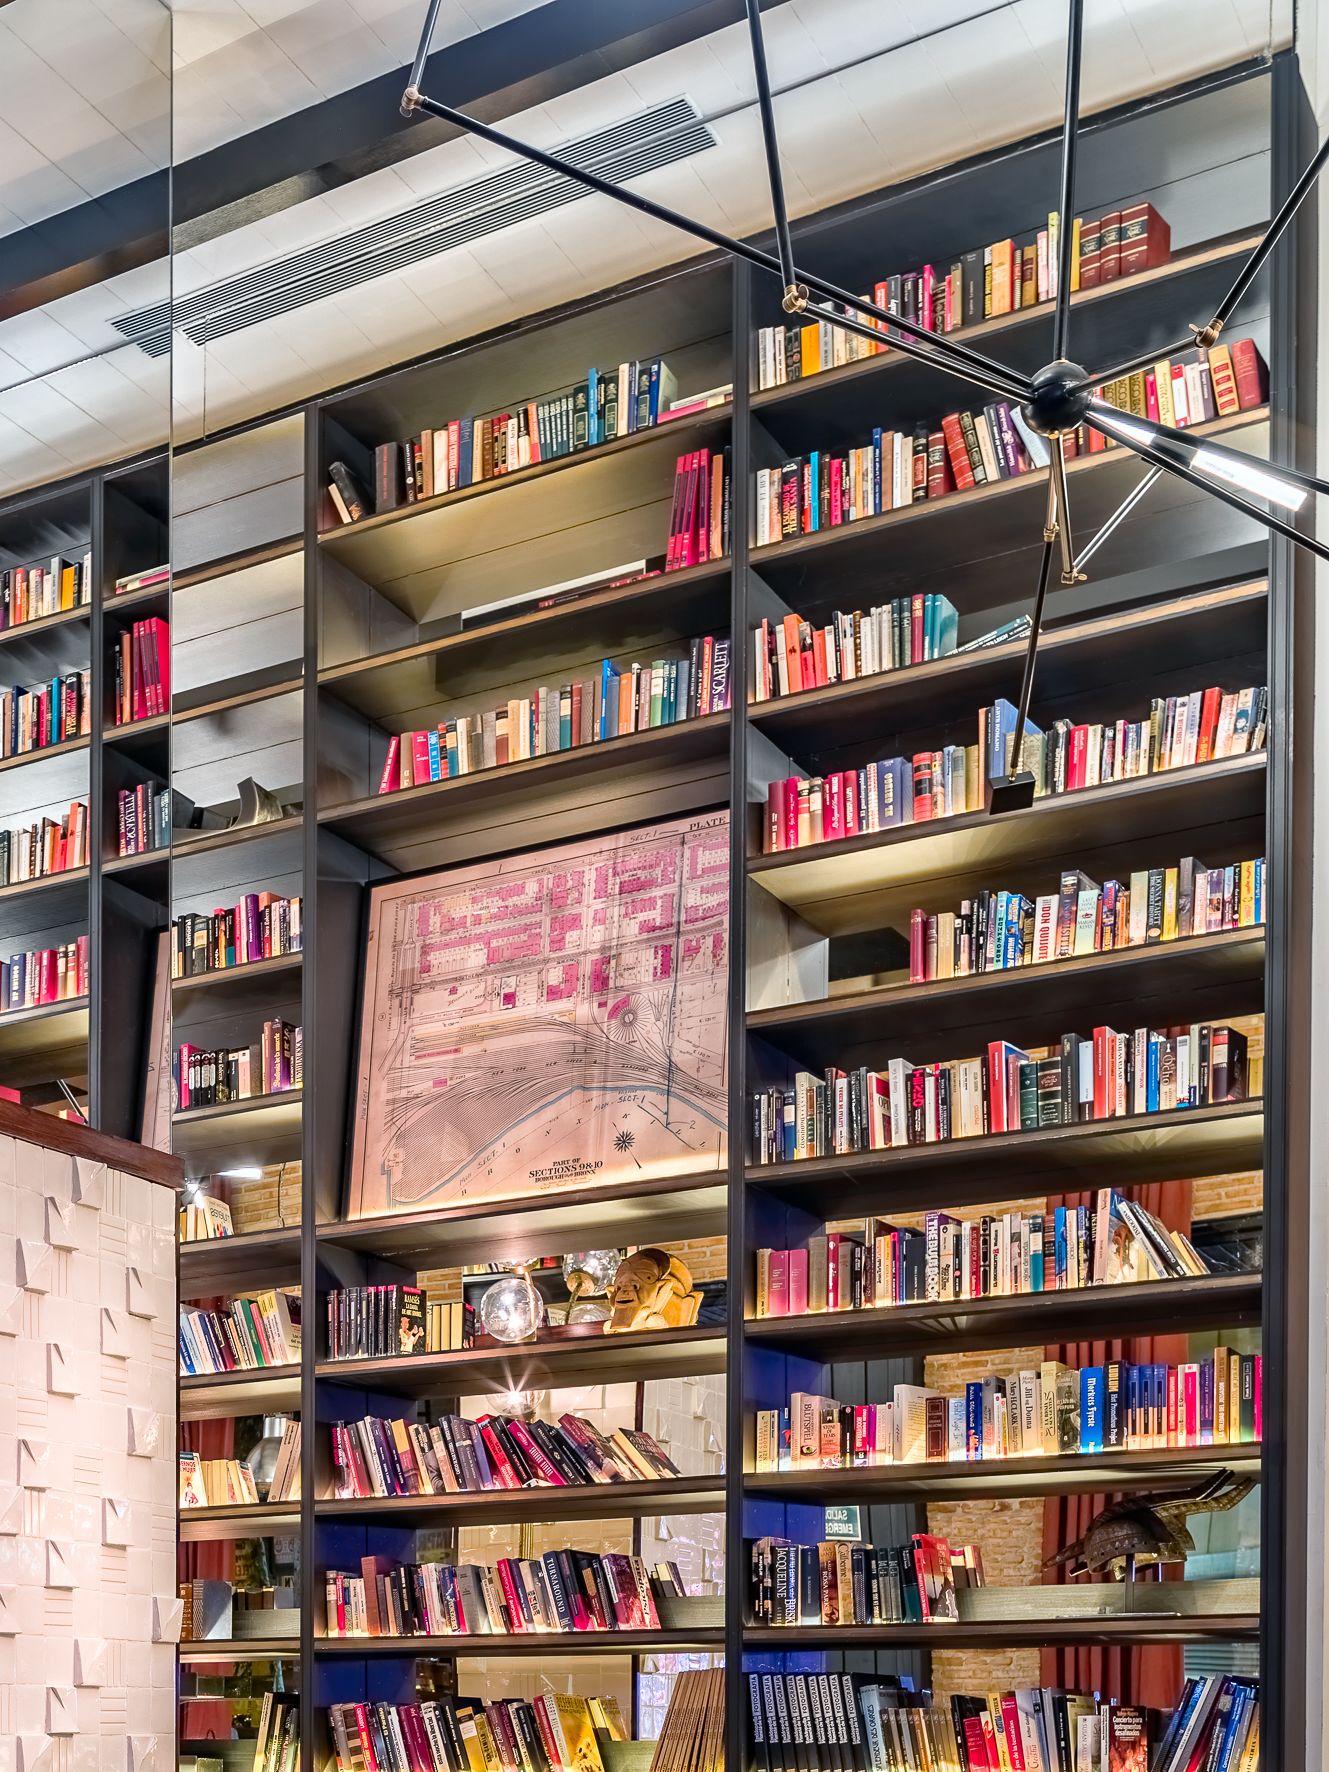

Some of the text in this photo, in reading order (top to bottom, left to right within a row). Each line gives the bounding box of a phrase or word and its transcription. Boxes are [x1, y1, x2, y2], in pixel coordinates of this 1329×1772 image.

[713, 643, 729, 695] SCARLETT
[689, 816, 727, 831] PLATE
[1038, 906, 1051, 960] DON QUIJOTE
[528, 1165, 577, 1180] SECTIONS
[552, 1160, 568, 1168] PART
[574, 1169, 597, 1179] BRONX
[1108, 1364, 1119, 1393] LUDLUM
[804, 1402, 812, 1445] BLUTSPIEL
[545, 1557, 566, 1614] TURNAROUND
[775, 1547, 789, 1599] JACQUELINE
